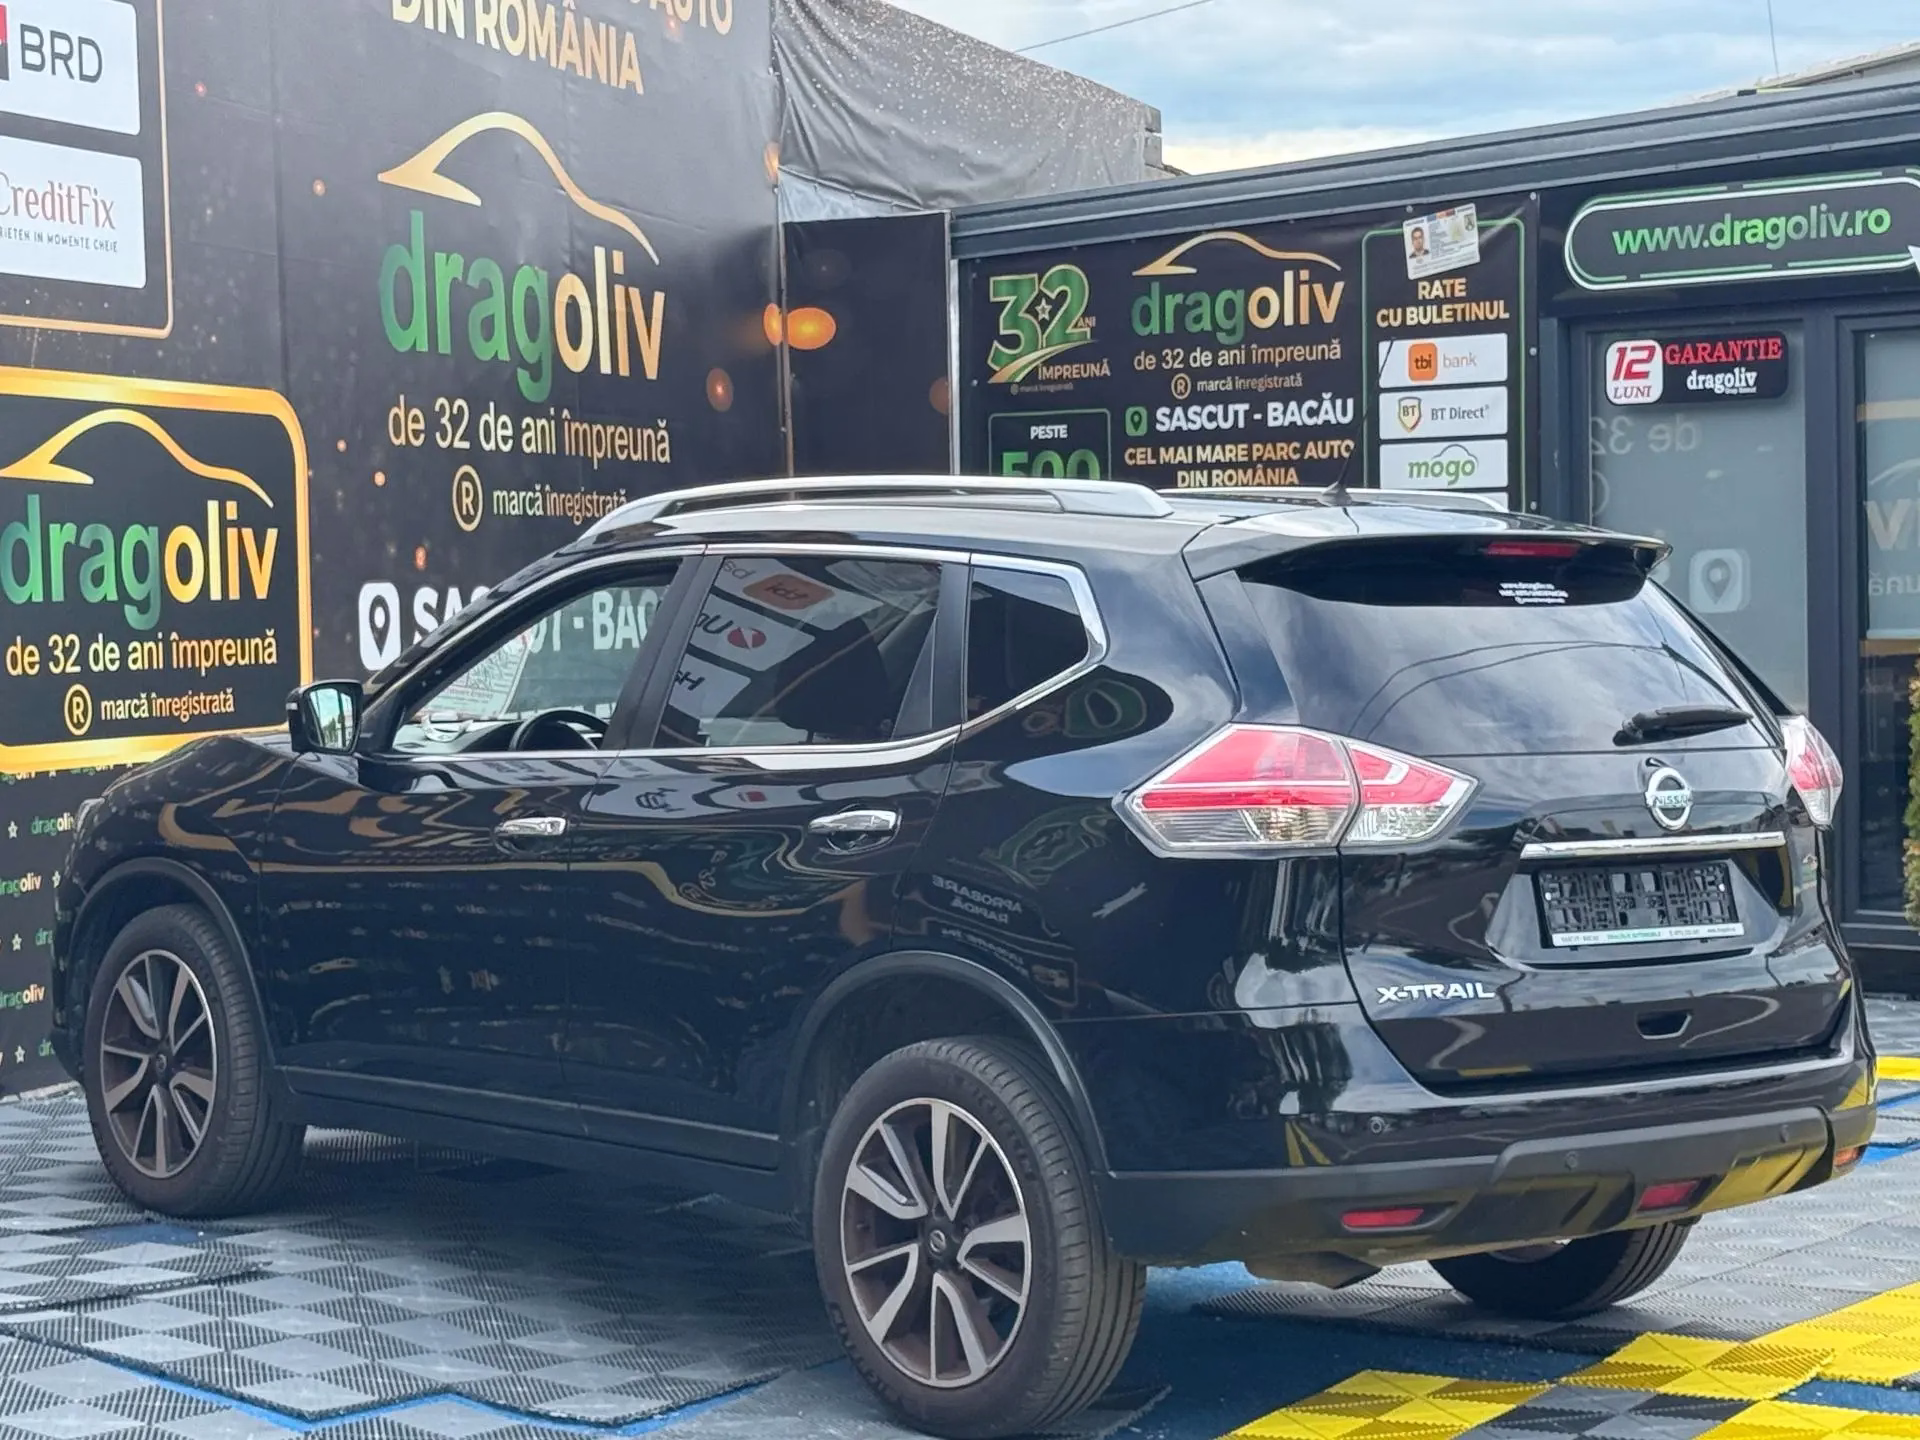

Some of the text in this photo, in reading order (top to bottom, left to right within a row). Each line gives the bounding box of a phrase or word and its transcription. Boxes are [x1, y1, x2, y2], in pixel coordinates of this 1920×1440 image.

[20, 23, 102, 83] BRD
[1612, 203, 1891, 255] www.dragoliv.ro
[1418, 278, 1467, 300] RATE
[379, 210, 665, 402] dragoliv
[988, 264, 1090, 371] 32
[1131, 270, 1345, 346] dragoliv
[1376, 300, 1509, 328] CU BULETINUL
[1133, 338, 1342, 371] de 32 de ani împreună
[1414, 353, 1433, 370] tbi
[1443, 352, 1478, 369] bank
[1612, 345, 1656, 381] 12
[1664, 337, 1782, 365] GARANTIE
[1197, 375, 1232, 393] marcă
[1234, 372, 1303, 392] înregistrată
[1613, 385, 1652, 400] LUNI
[1687, 367, 1757, 394] dragoliv
[1156, 403, 1250, 433] SASCUT
[1267, 392, 1354, 428] BACĂU
[1402, 405, 1417, 418] BT
[1431, 407, 1447, 421] BT
[388, 395, 671, 469] de 32 de ani împreună
[1030, 425, 1068, 440] PESTE
[1125, 439, 1355, 466] CEL MAI MARE PARC AUTO
[1177, 463, 1299, 489] DIN ROMÂNIA
[1408, 459, 1476, 486] mogo
[493, 484, 544, 516] marcă
[0, 494, 278, 630] dragoliv
[6, 629, 277, 677] de 32 de ani împreună
[101, 693, 149, 720] marcă
[151, 688, 235, 723] înregistrată
[1377, 982, 1496, 1003] X-TRAIL
